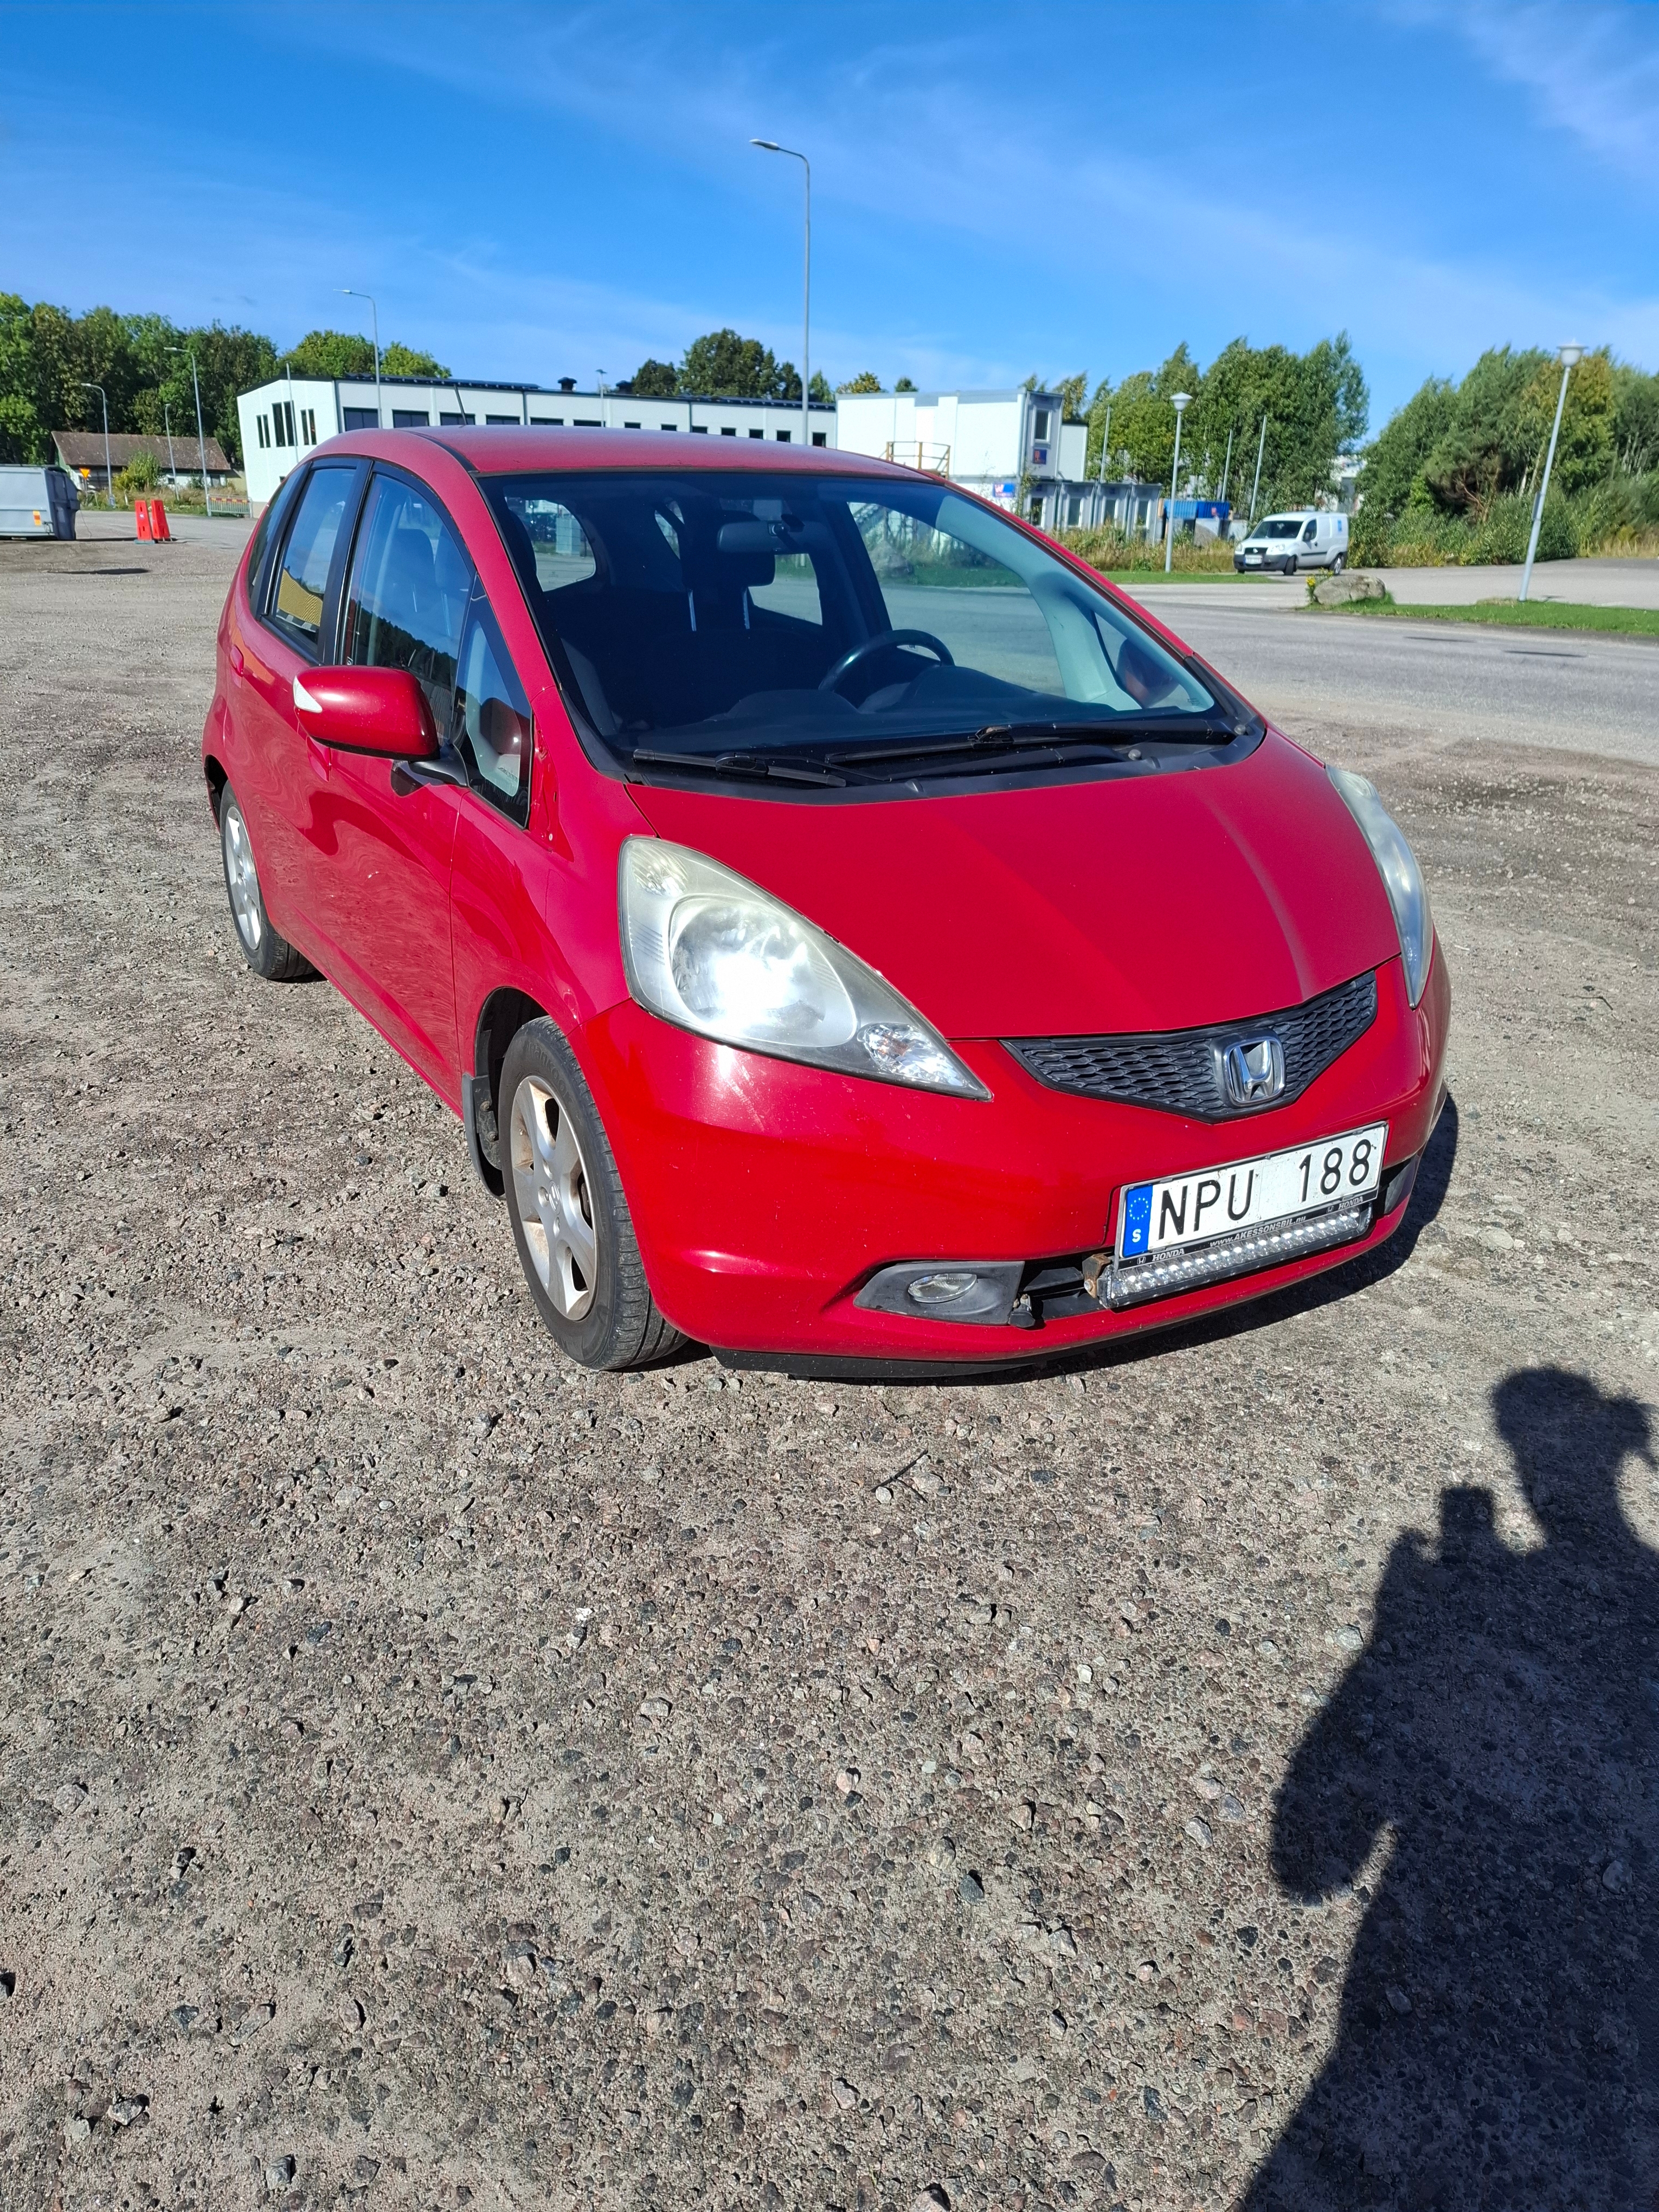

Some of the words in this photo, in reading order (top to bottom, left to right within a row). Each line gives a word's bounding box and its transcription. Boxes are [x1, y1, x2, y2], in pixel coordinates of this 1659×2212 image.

[1158, 1169, 1254, 1240] NPU
[1298, 1139, 1372, 1203] 188
[1338, 1196, 1363, 1210] HONDA
[1132, 1229, 1141, 1243] S
[1152, 1249, 1185, 1262] HONDA
